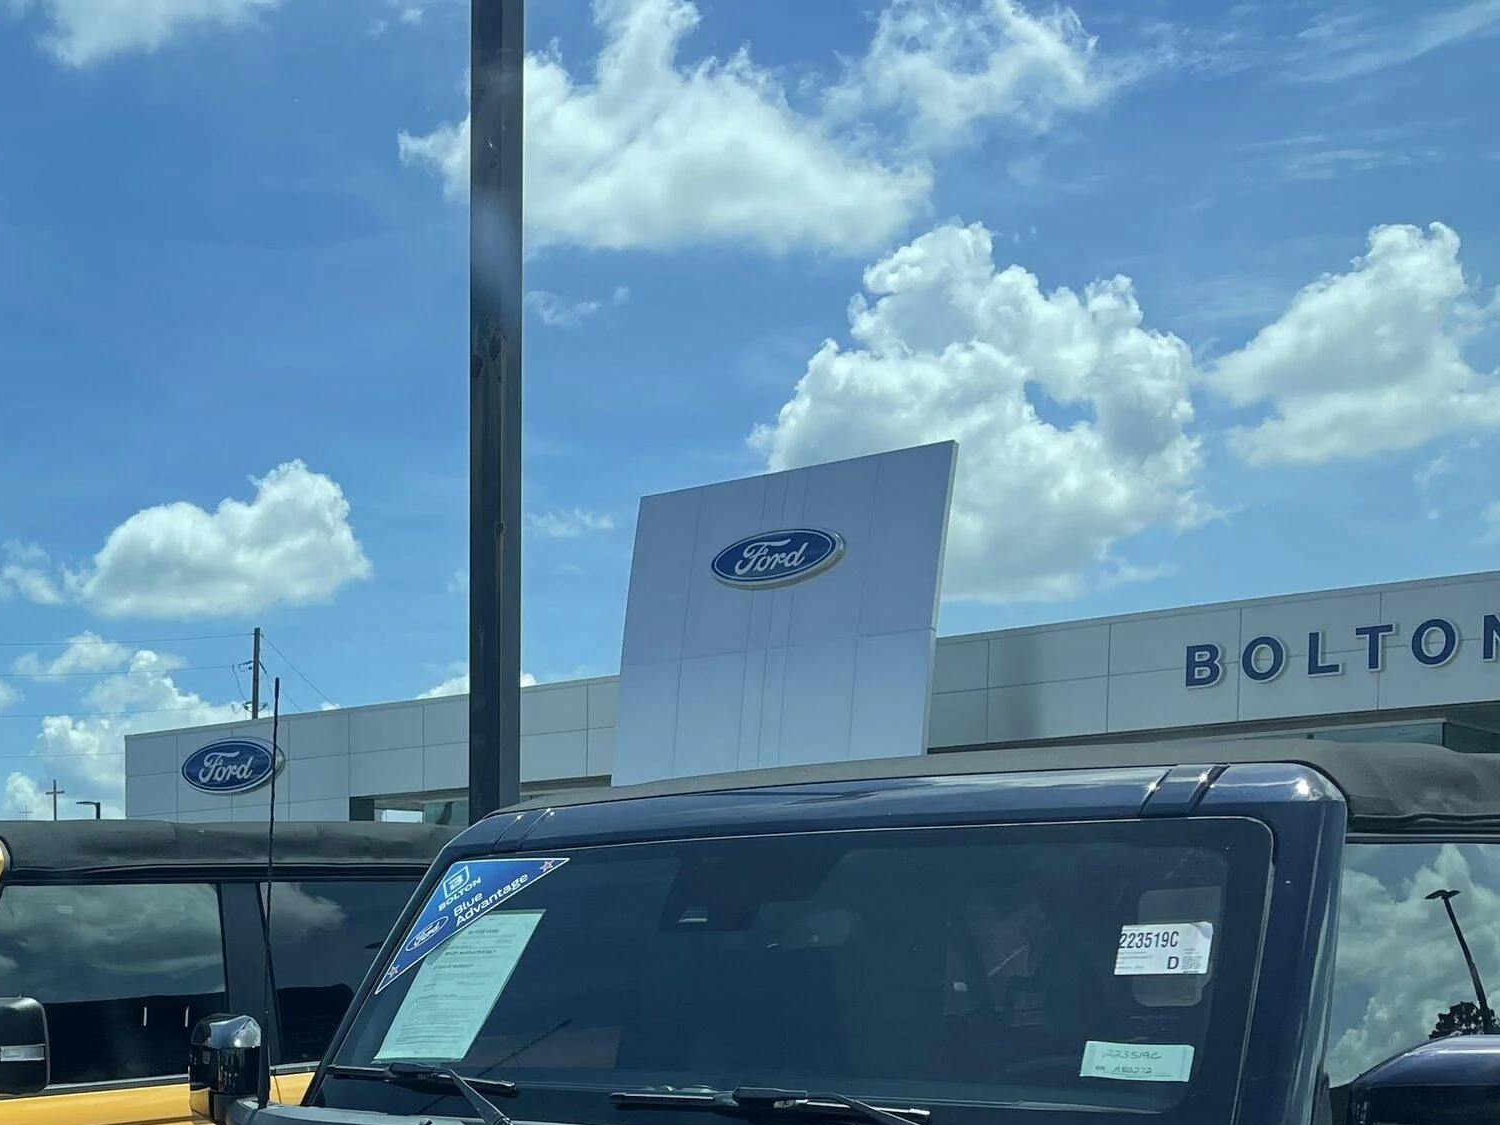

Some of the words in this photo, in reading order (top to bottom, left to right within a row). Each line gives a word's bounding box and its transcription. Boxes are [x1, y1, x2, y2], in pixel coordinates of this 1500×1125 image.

[734, 538, 809, 575] Ford
[198, 750, 254, 783] Ford
[438, 877, 482, 911] BOLTON
[453, 892, 483, 917] Blue
[456, 874, 529, 927] Advantage
[413, 921, 441, 947] Ford
[1119, 931, 1180, 949] 223519C
[1167, 956, 1180, 970] D
[1101, 1049, 1163, 1060] 223519C
